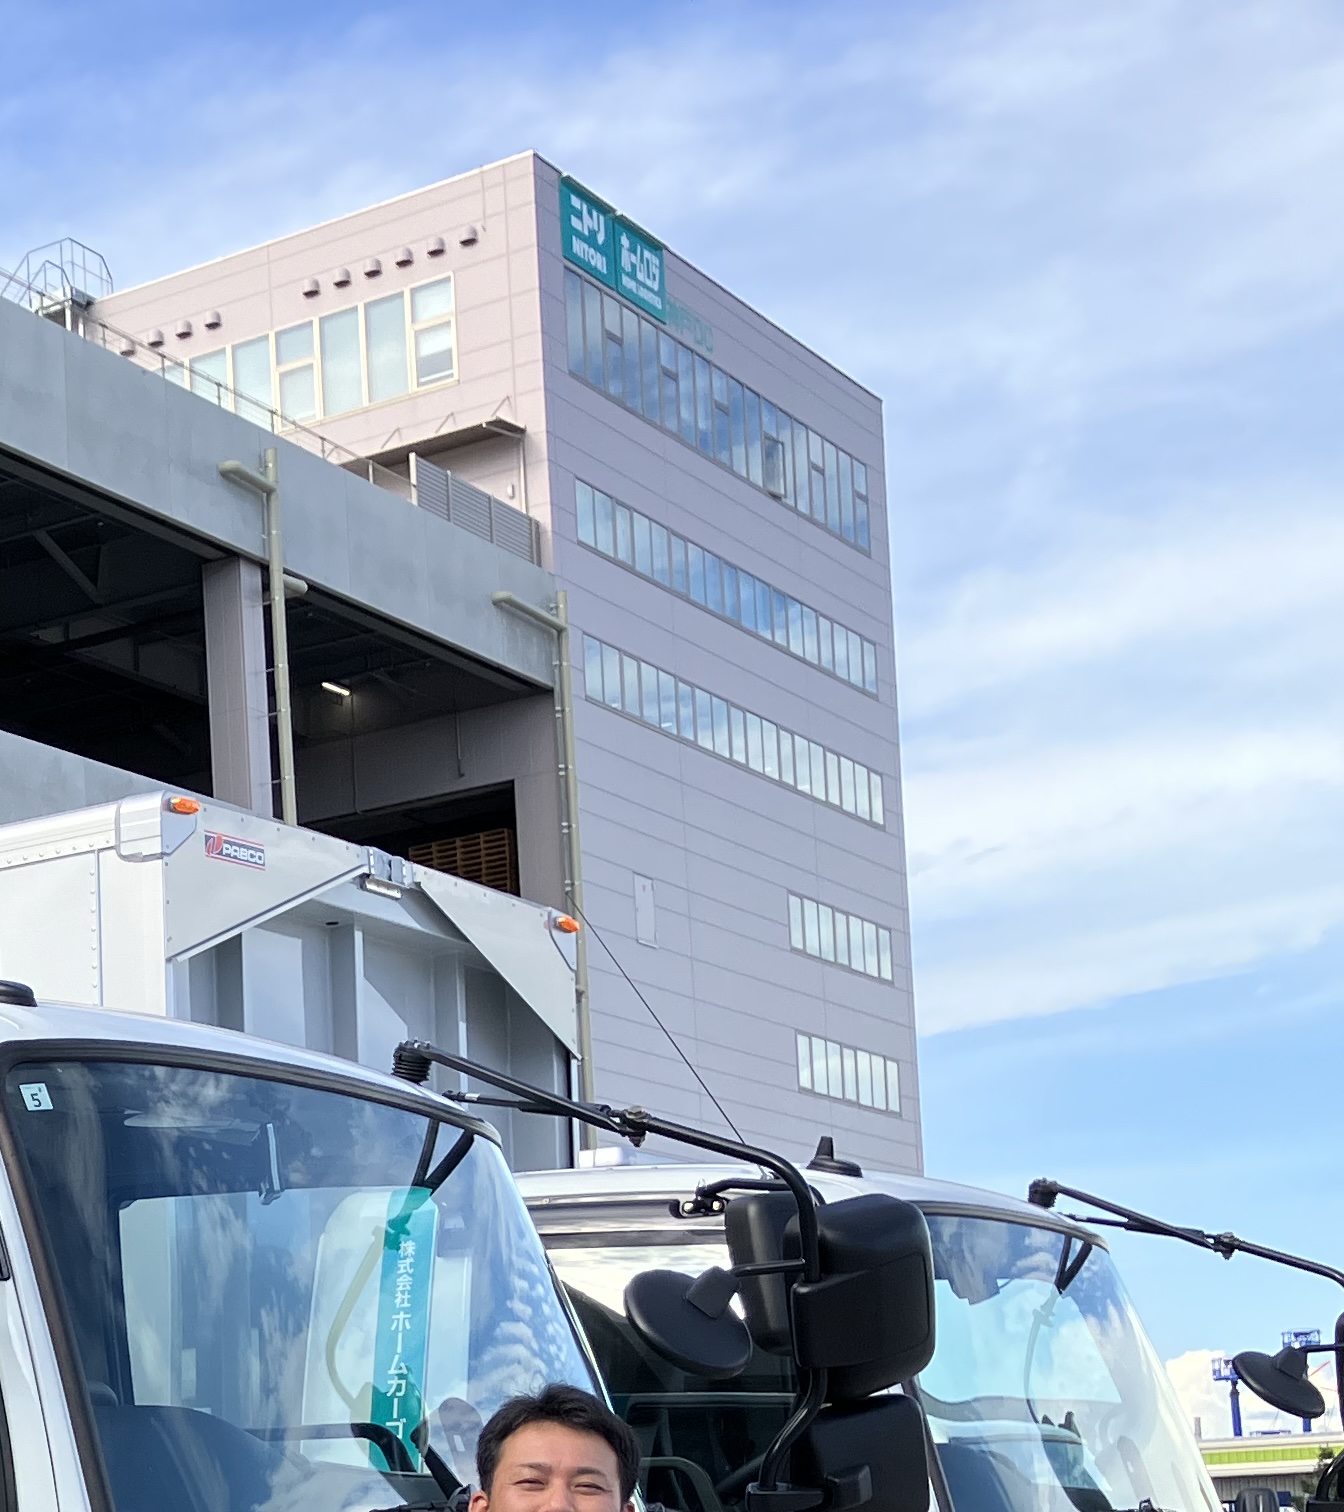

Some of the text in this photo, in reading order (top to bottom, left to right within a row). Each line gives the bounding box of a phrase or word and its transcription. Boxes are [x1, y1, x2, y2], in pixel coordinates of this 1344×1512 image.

[569, 193, 606, 246] ニトリ
[571, 234, 608, 275] NITORI
[222, 843, 264, 865] PABCO
[30, 1092, 42, 1108] 5
